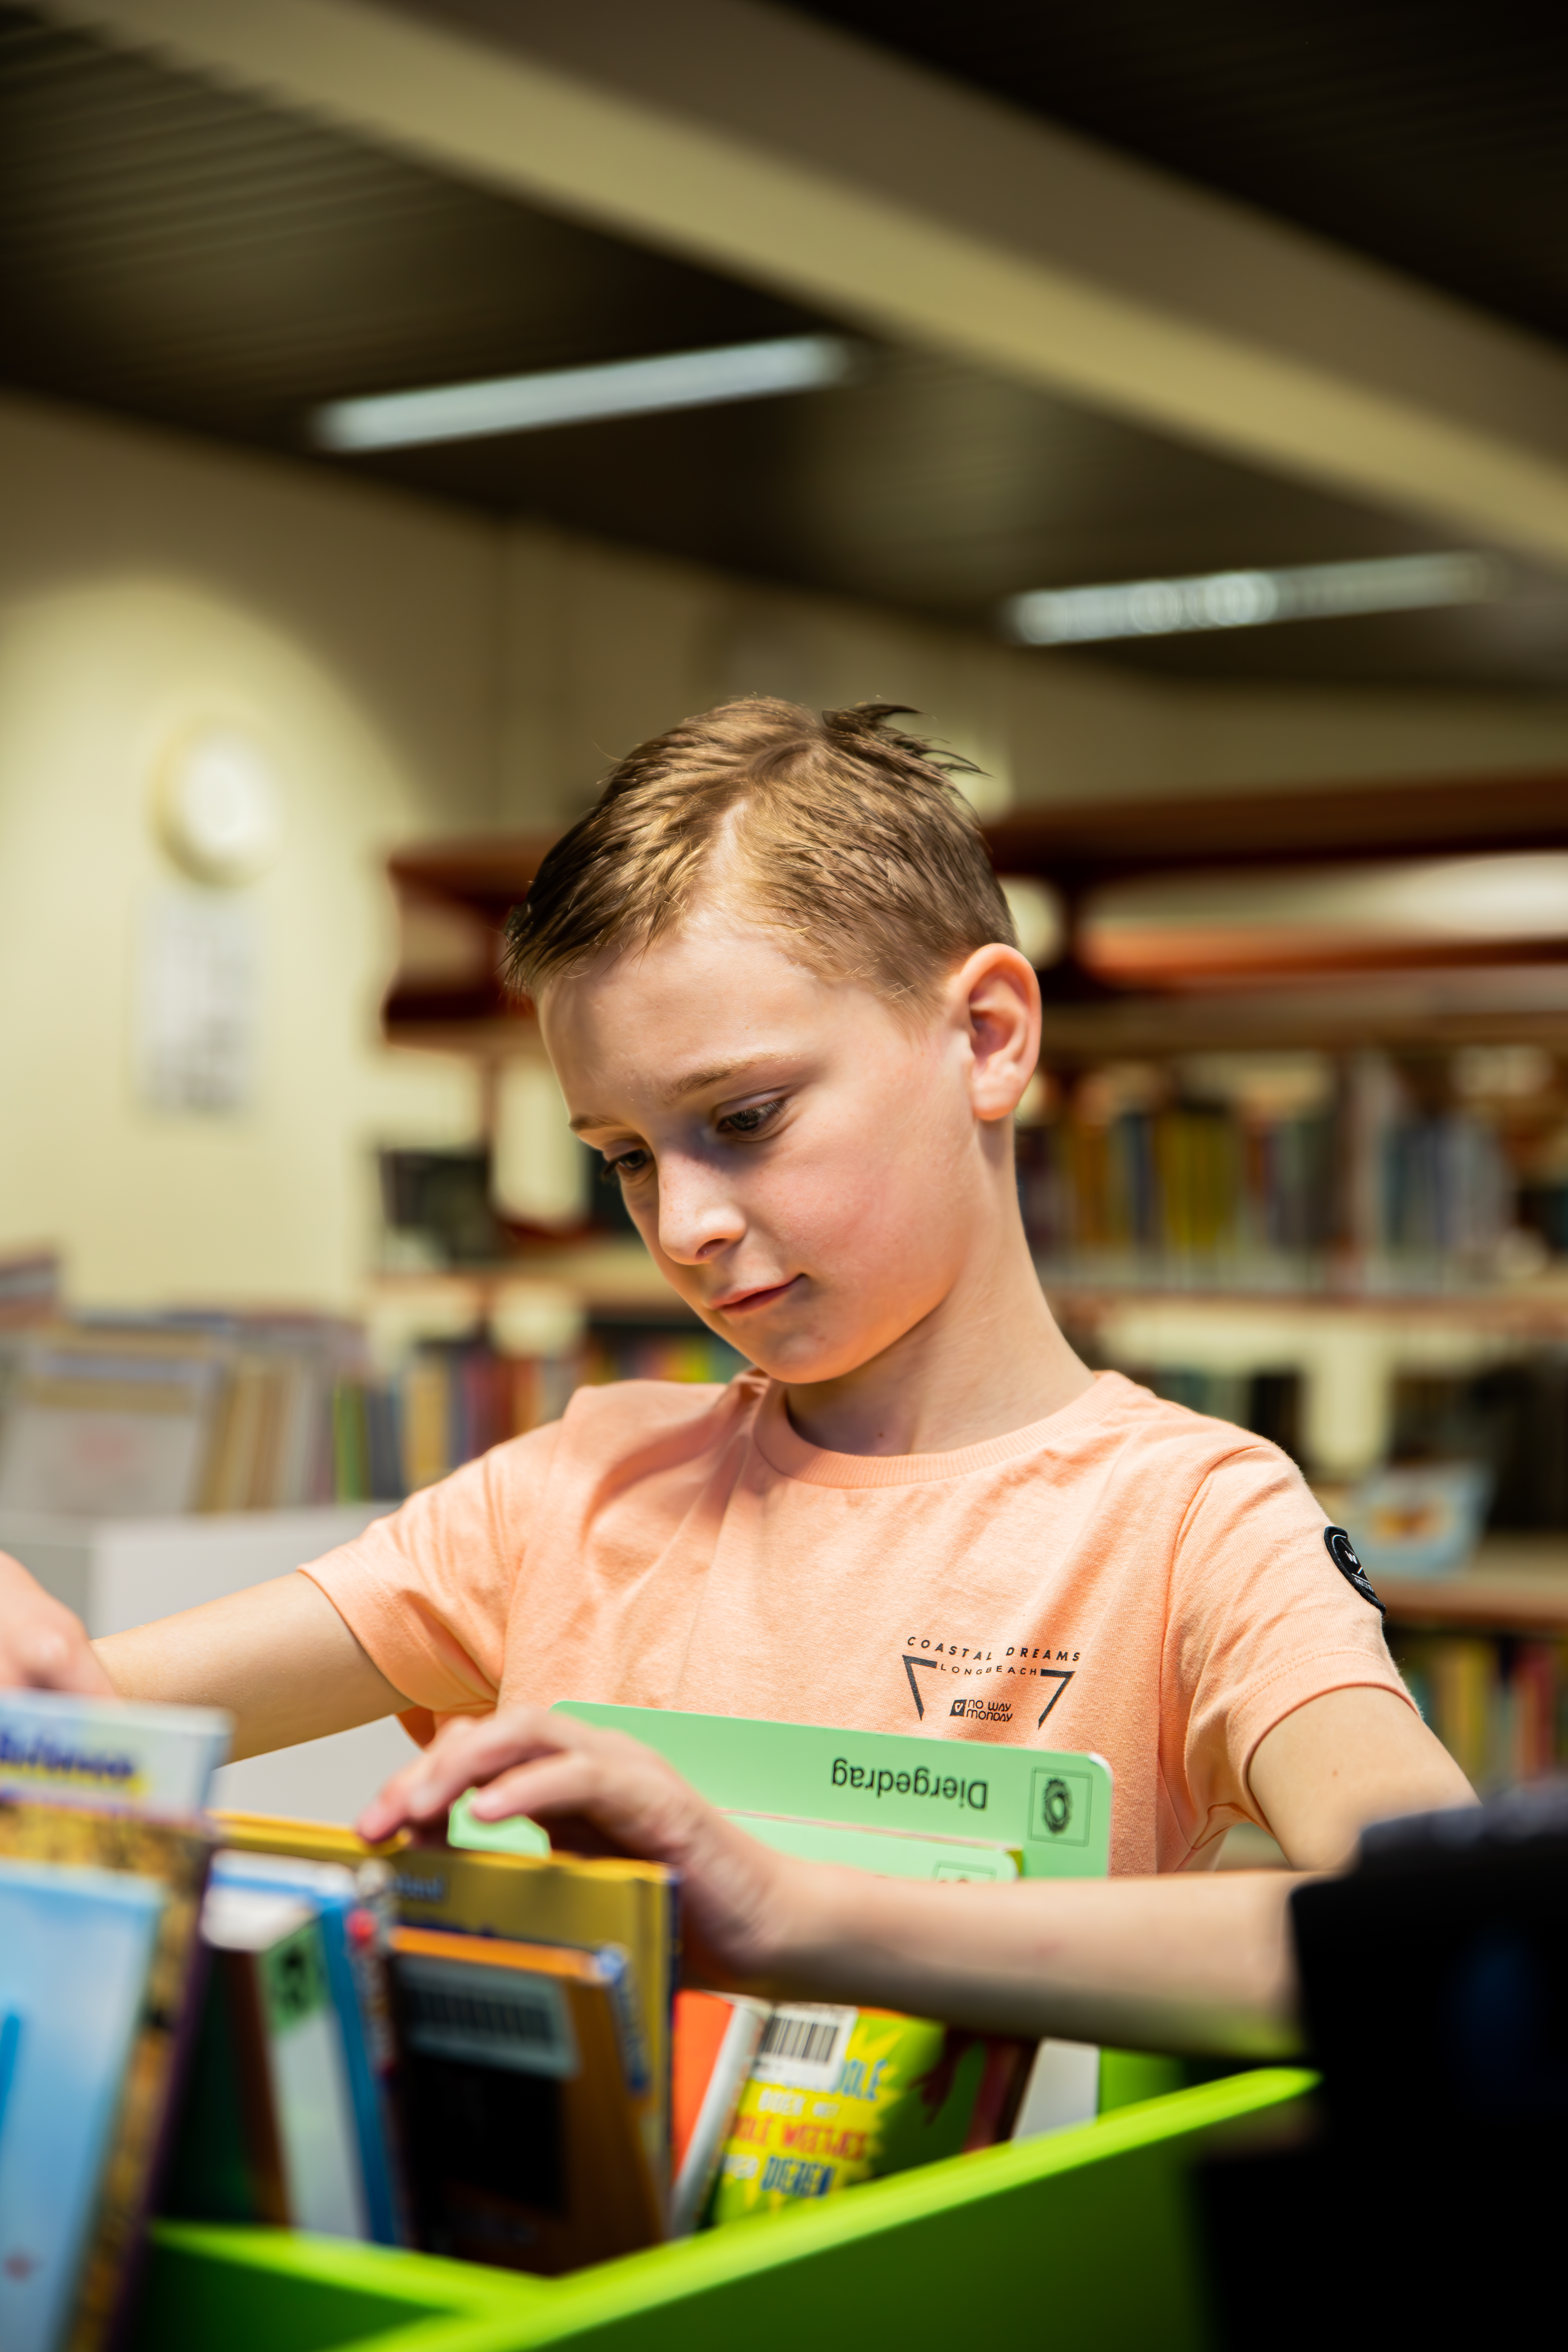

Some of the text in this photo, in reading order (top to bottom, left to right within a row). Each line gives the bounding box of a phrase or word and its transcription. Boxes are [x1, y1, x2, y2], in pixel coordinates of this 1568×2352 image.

[907, 1636, 1081, 1661] COASTAL DREAMS
[940, 1663, 1037, 1676] LONGBEACH
[831, 1756, 988, 1810] Diergedrag
